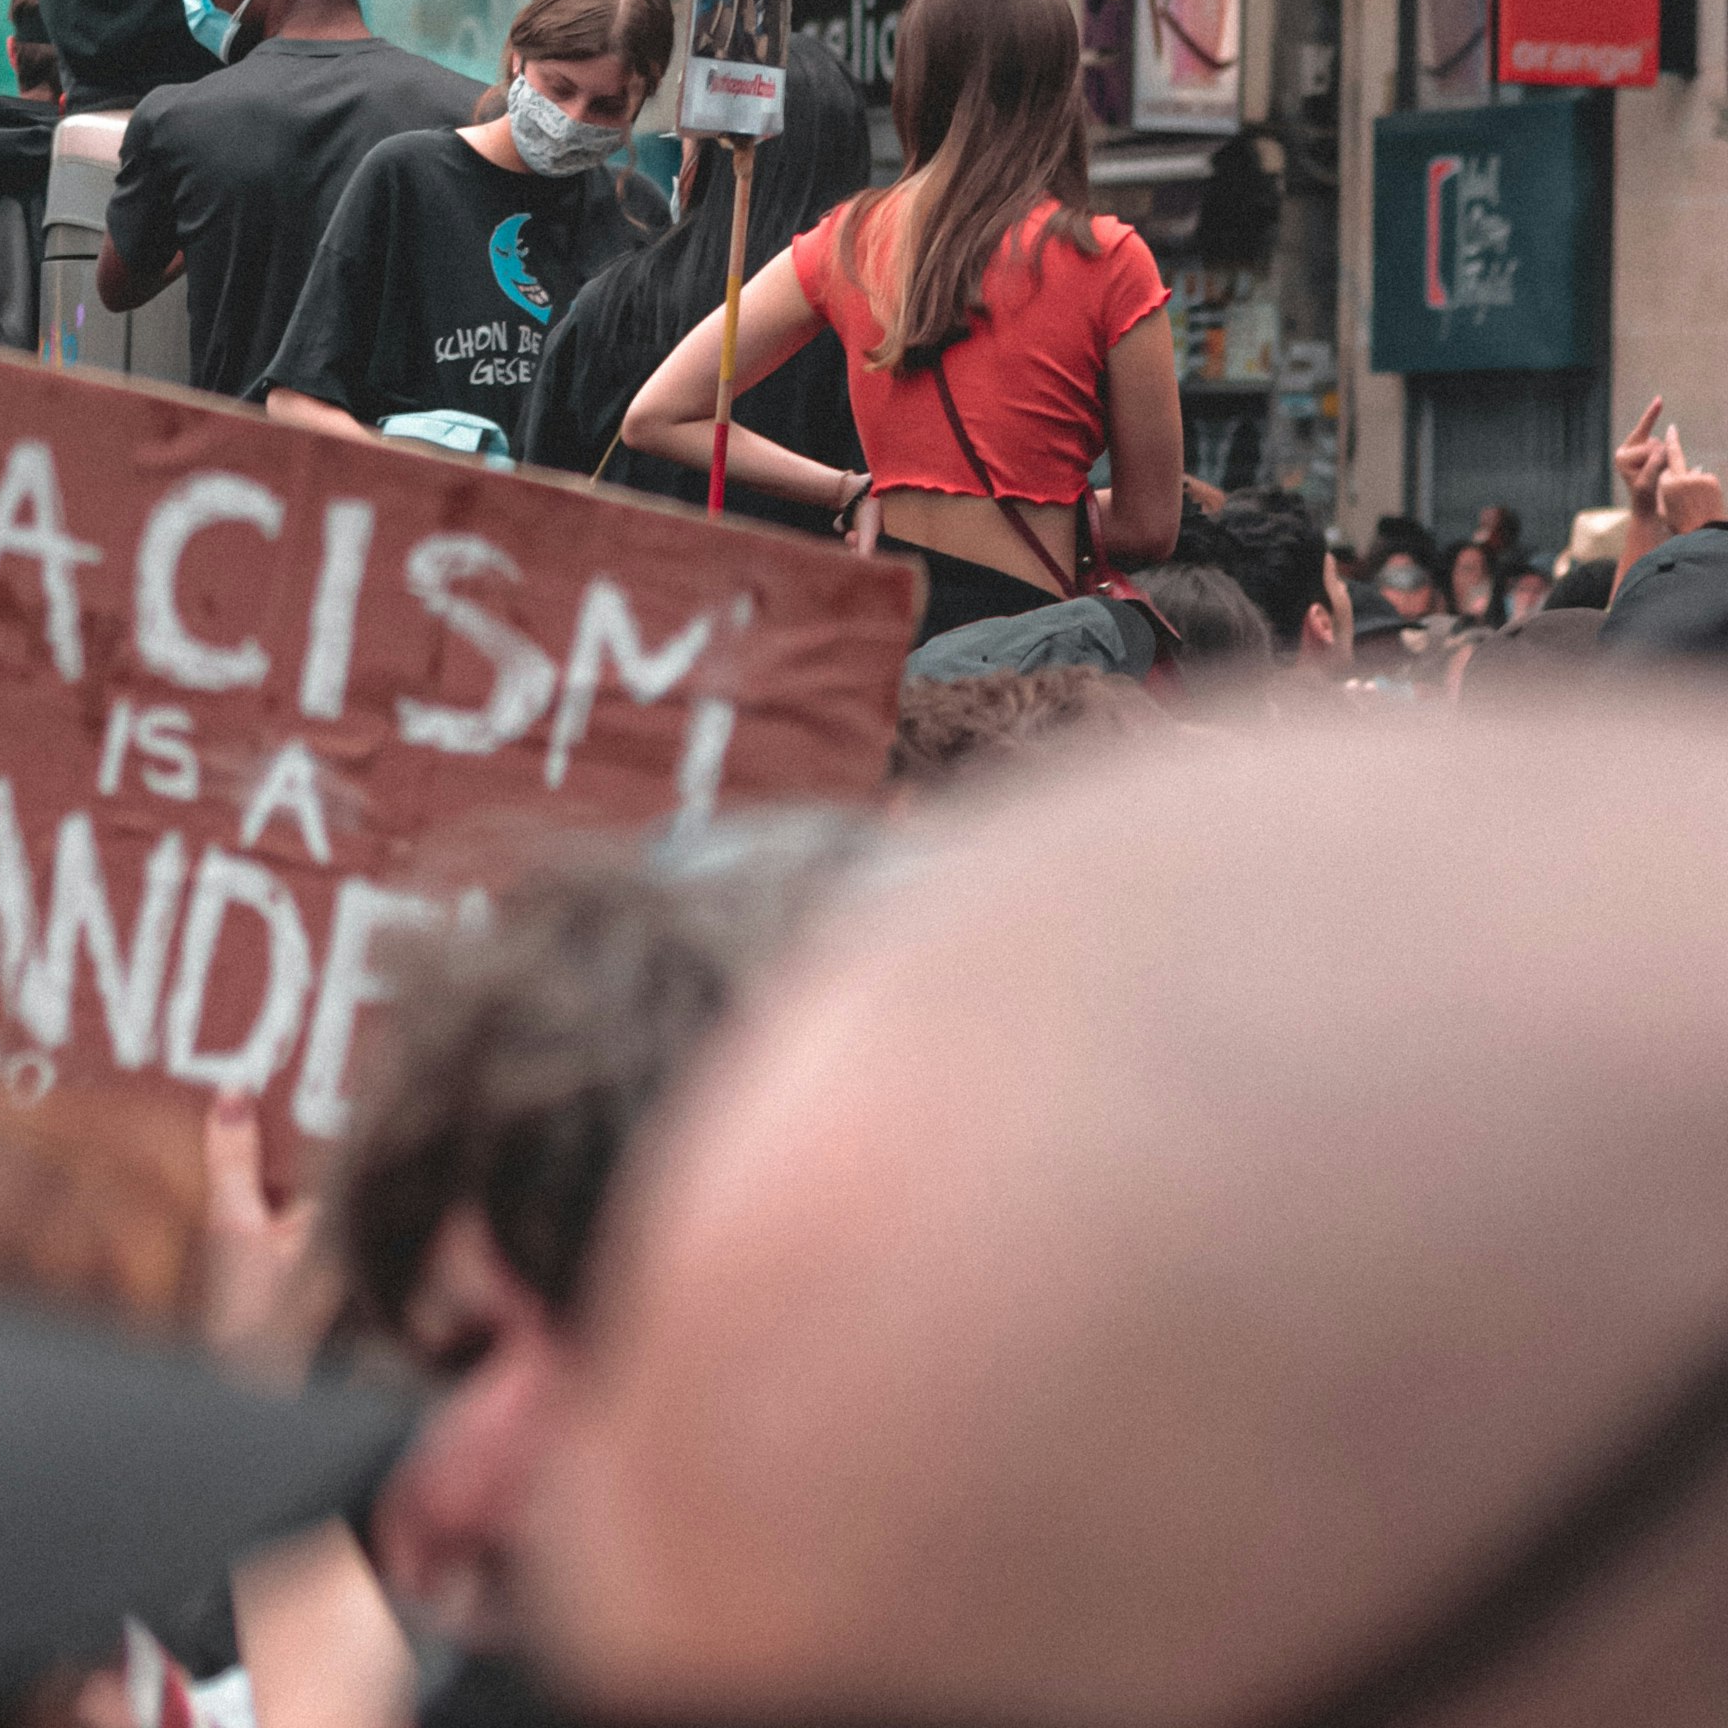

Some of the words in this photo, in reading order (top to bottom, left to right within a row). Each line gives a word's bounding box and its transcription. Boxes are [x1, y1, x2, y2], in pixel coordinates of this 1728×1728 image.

[1511, 42, 1644, 82] orange
[434, 321, 508, 364] SCHON
[469, 357, 536, 386] GESE
[97, 698, 202, 802] IS
[241, 741, 333, 864] A
